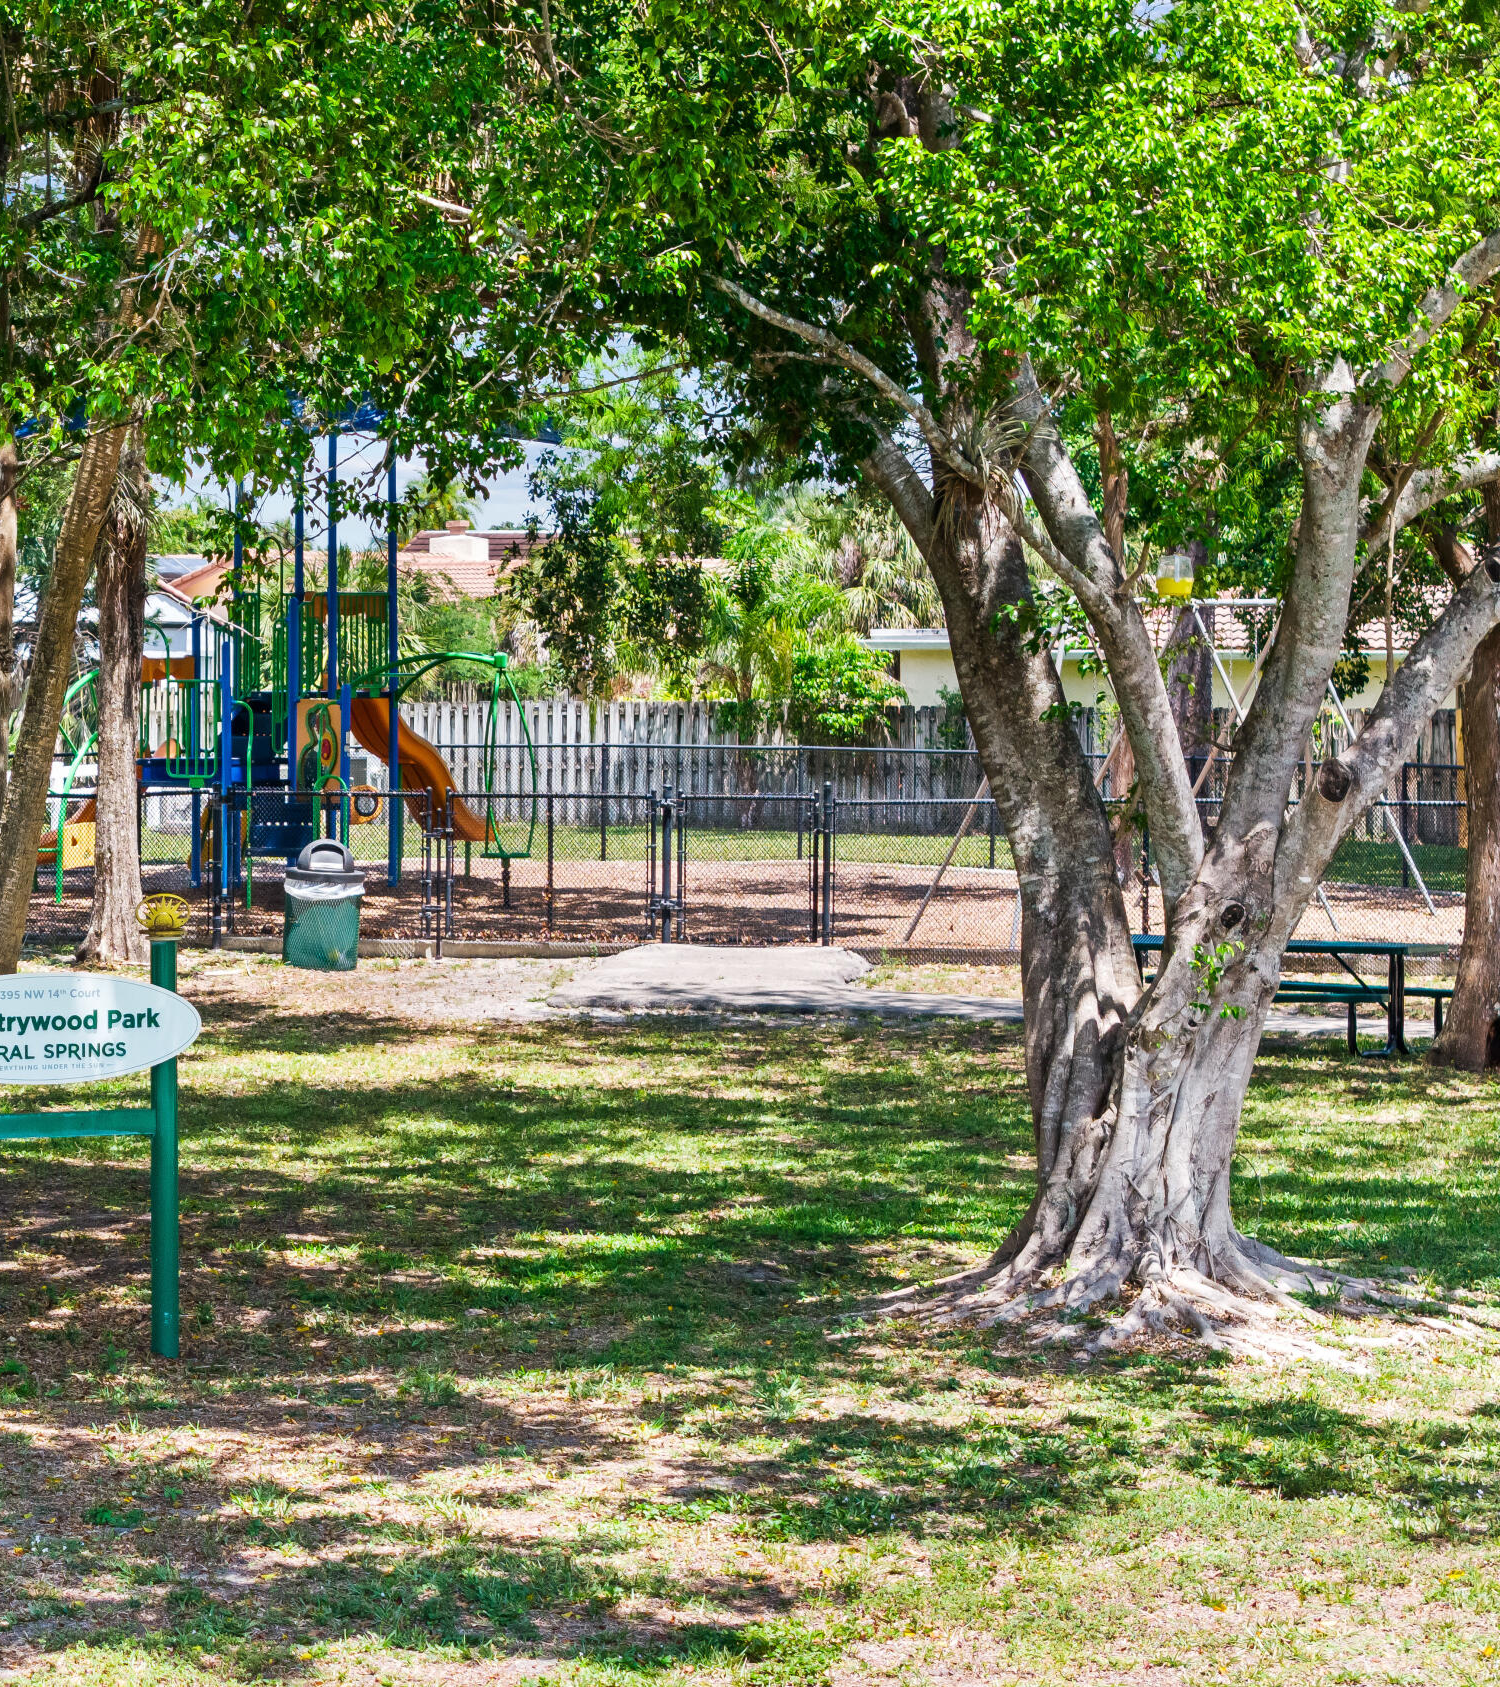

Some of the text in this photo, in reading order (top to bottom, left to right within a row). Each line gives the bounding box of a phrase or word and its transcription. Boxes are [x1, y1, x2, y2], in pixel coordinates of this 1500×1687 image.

[24, 990, 45, 999] NW
[70, 988, 101, 998] Court
[107, 1007, 161, 1030] Park
[43, 1042, 127, 1060] SPRINGS
